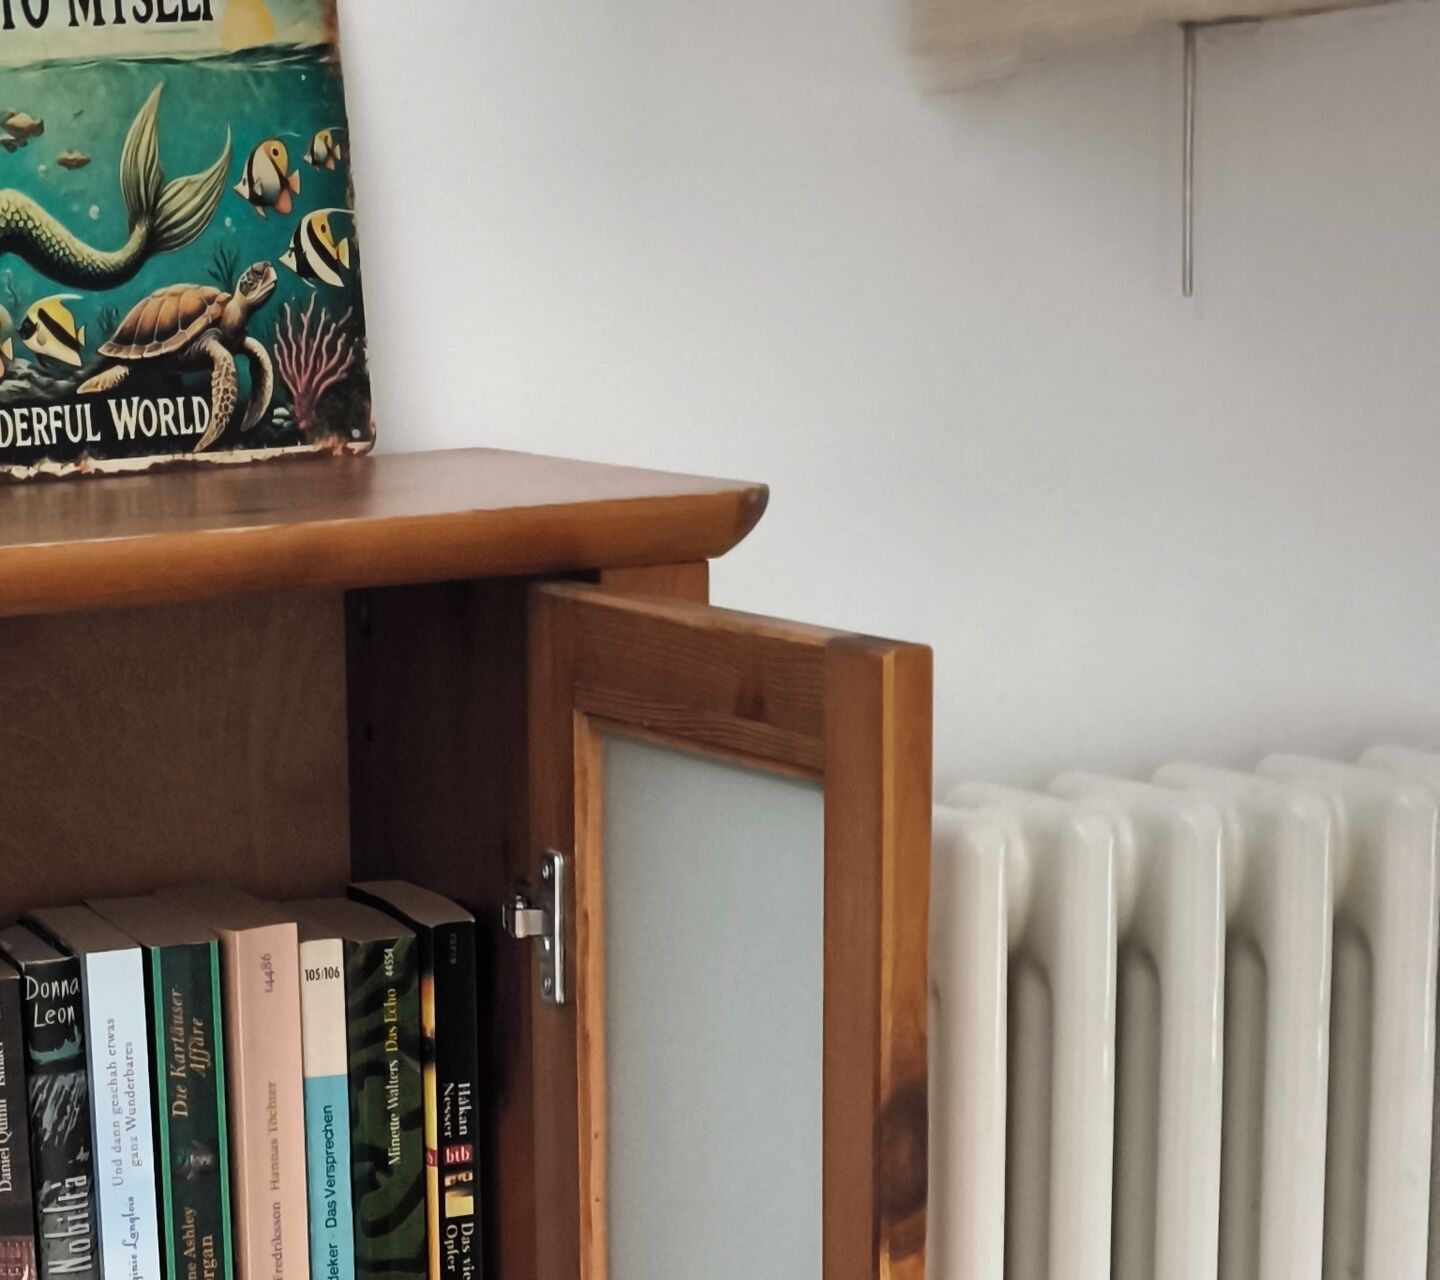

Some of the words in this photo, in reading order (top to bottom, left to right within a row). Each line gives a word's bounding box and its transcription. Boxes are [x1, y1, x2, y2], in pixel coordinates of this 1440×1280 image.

[111, 396, 211, 442] WORLD
[26, 976, 81, 1001] Donna
[383, 988, 398, 1023] Echo
[33, 1003, 76, 1028] Leon
[384, 1026, 399, 1053] Das
[106, 1063, 123, 1117] geschah
[123, 1040, 138, 1131] Wunderbares
[172, 1084, 189, 1119] Die
[386, 1059, 400, 1111] Walters
[268, 1082, 279, 1137] Töchter
[444, 1082, 455, 1138] Nesser
[458, 1082, 472, 1136] Håkan
[111, 1119, 122, 1158] dann
[129, 1132, 143, 1167] ganz
[321, 1104, 336, 1199] Versprechen
[387, 1113, 402, 1165] Minette
[445, 1146, 471, 1164] btb
[111, 1159, 123, 1187] Und
[270, 1139, 281, 1191] Hannas
[182, 1207, 198, 1259] Ashley
[325, 1199, 338, 1229] Das
[444, 1224, 459, 1272] Opfer
[460, 1222, 475, 1253] Das
